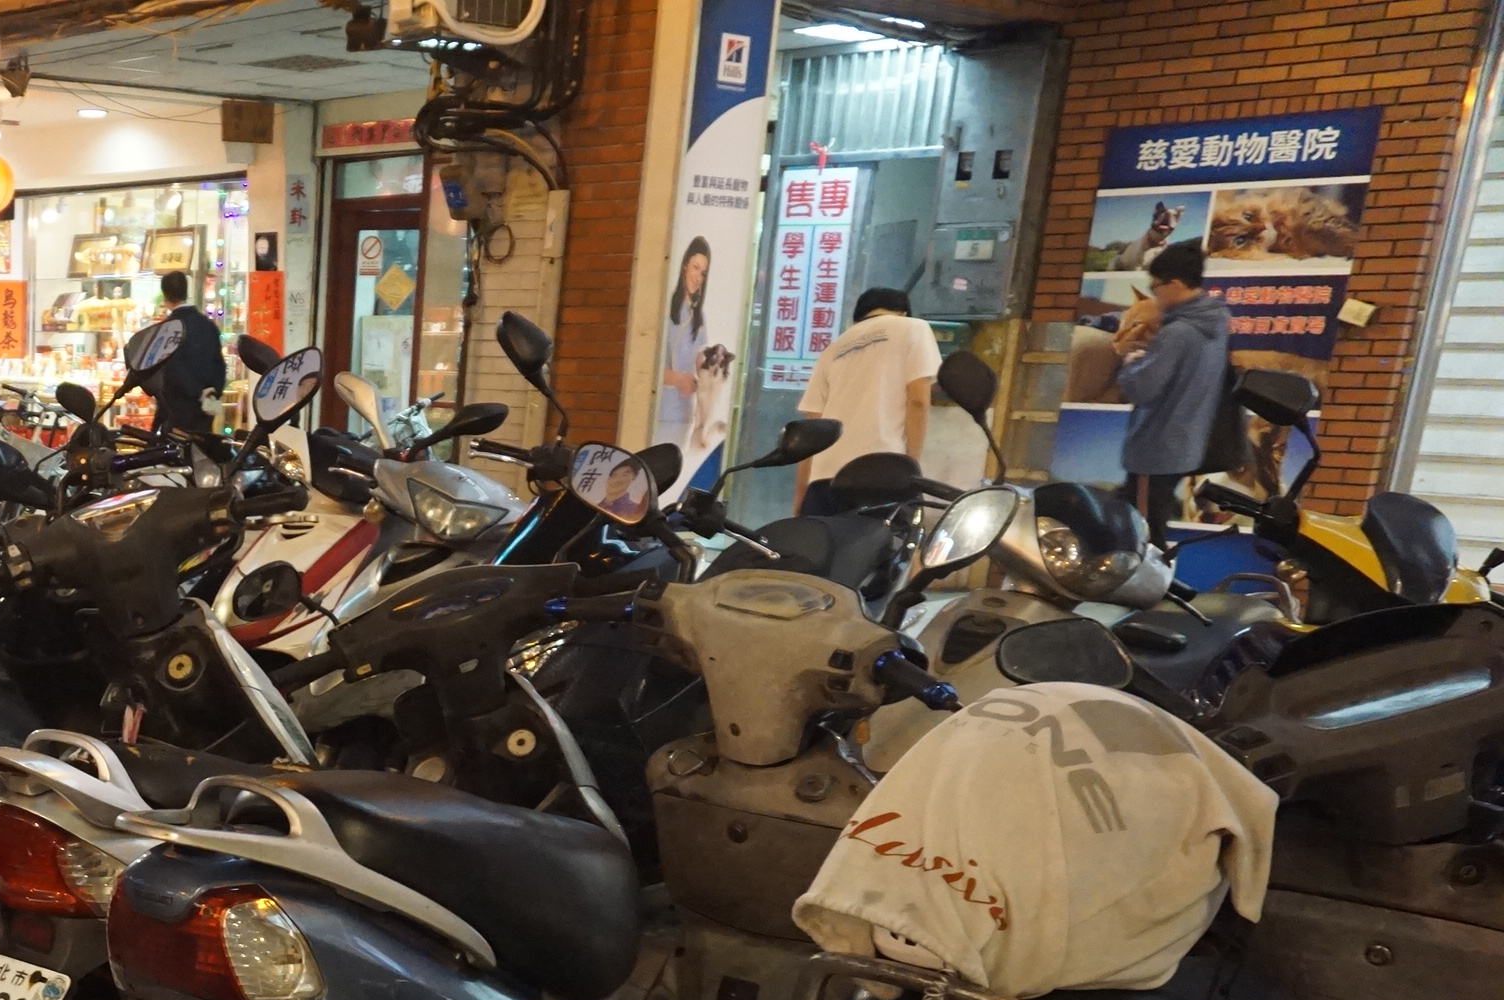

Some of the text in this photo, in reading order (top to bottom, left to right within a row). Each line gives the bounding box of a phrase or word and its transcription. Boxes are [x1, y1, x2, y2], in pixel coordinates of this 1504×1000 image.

[1136, 126, 1341, 171] 慈愛動物醫院
[773, 232, 805, 352] 學生制服
[808, 231, 842, 352] 學生運動服
